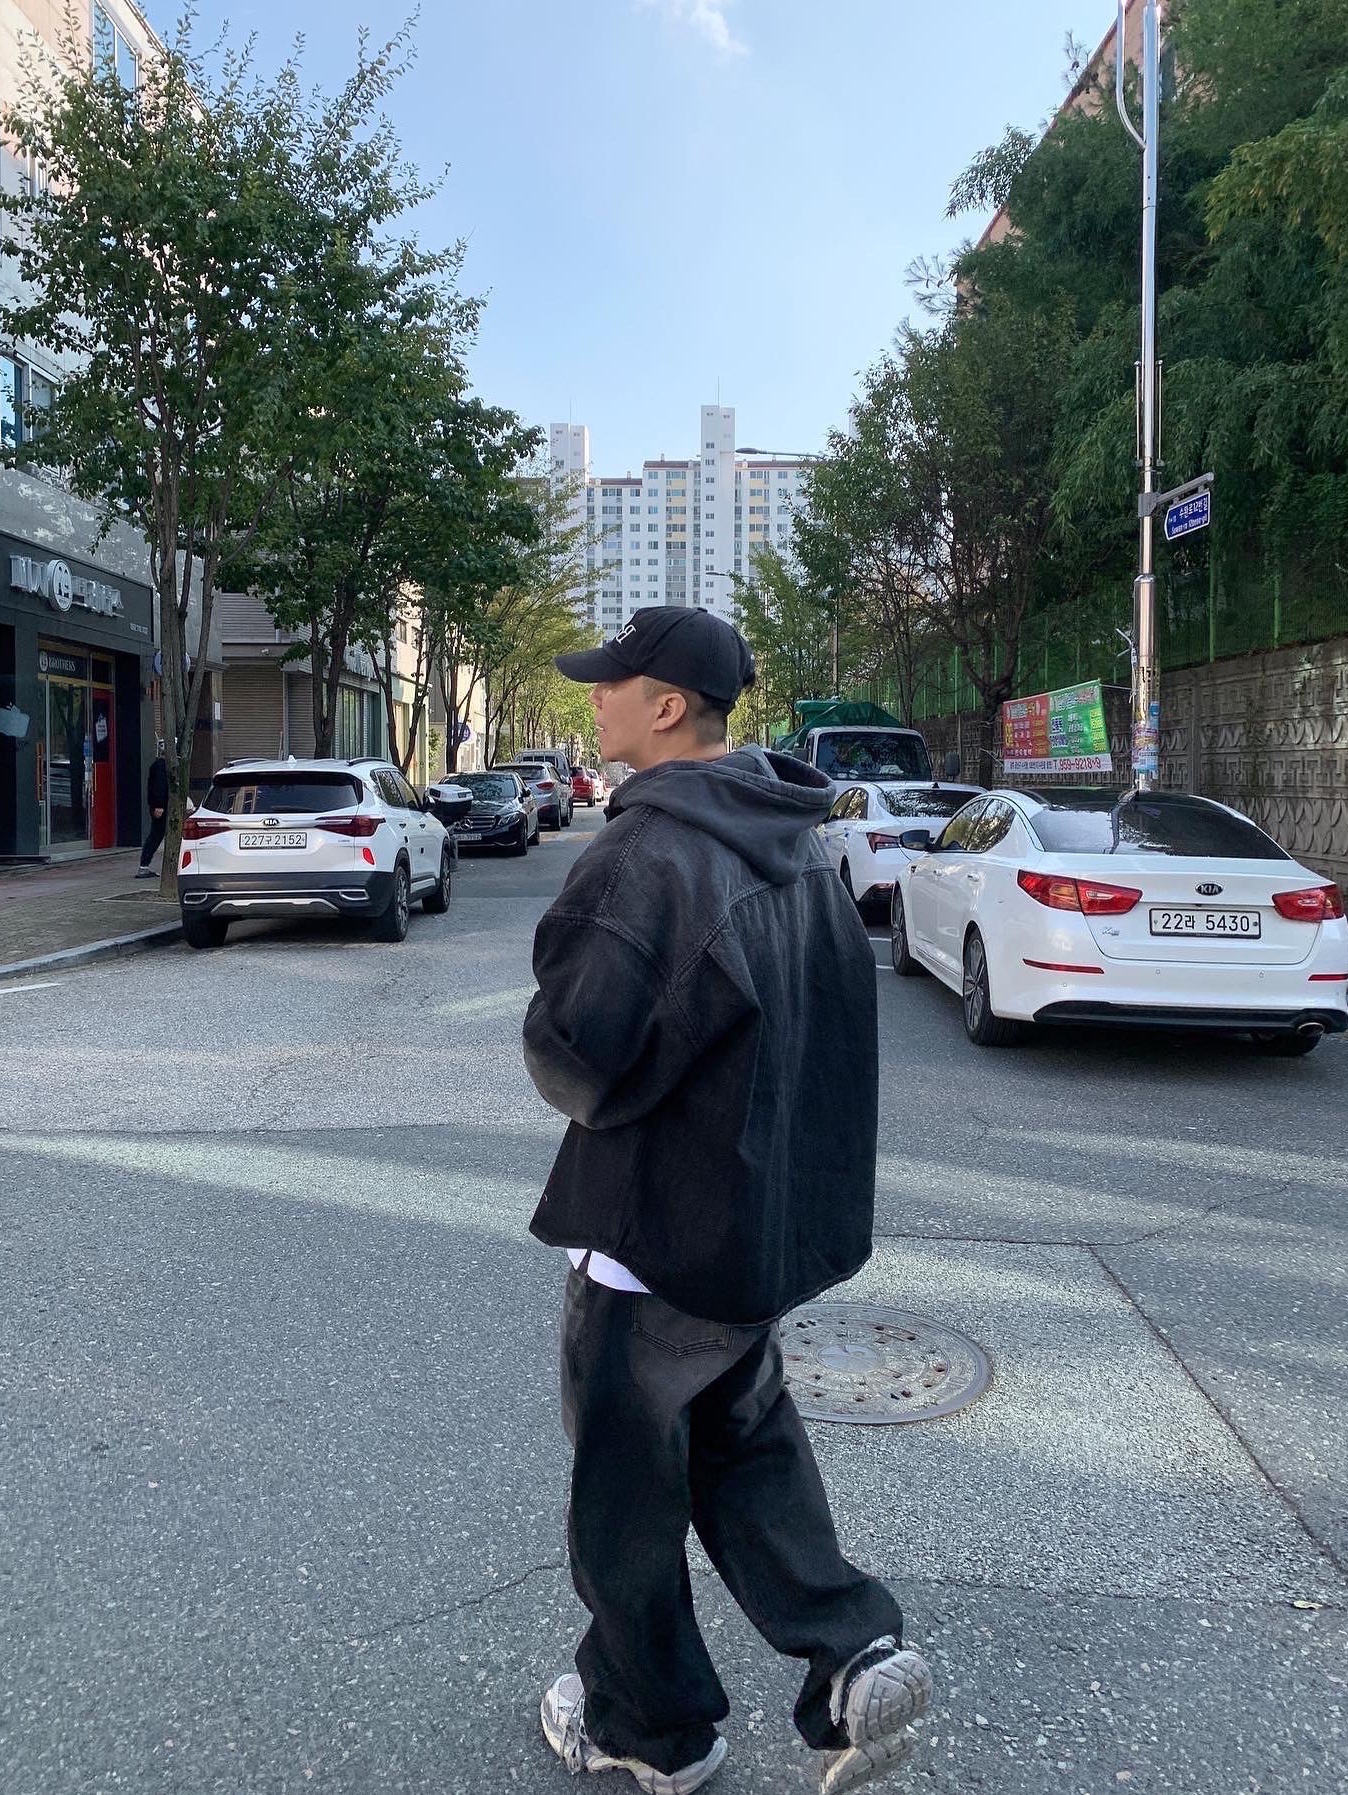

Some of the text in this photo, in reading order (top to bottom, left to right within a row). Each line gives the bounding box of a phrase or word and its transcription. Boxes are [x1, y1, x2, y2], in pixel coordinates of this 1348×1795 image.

[1200, 884, 1220, 894] KIA
[1161, 912, 1250, 932] 22라 5430
